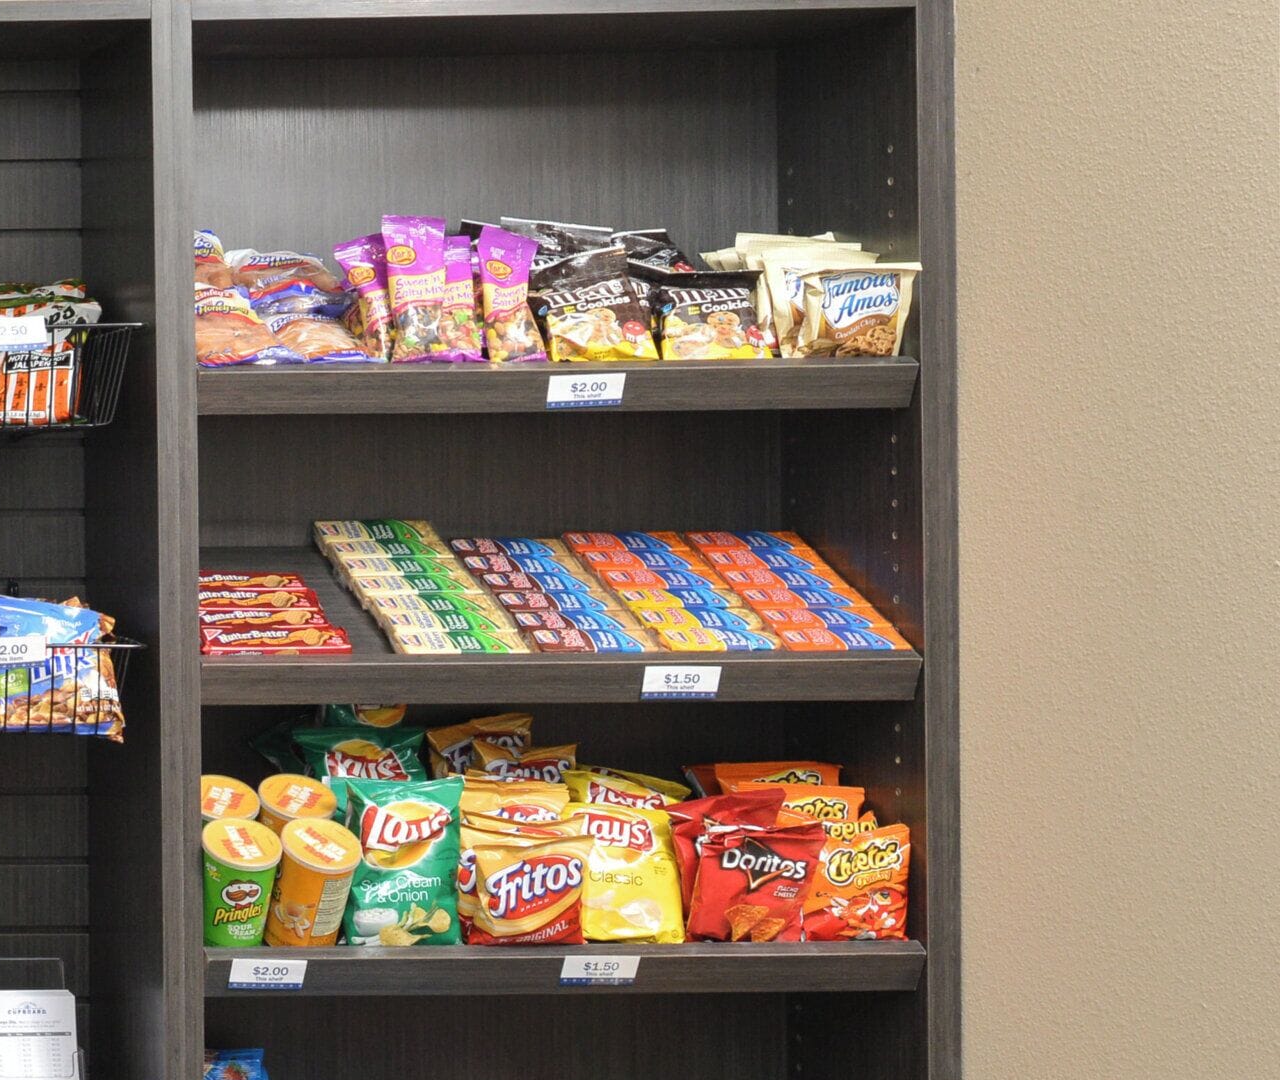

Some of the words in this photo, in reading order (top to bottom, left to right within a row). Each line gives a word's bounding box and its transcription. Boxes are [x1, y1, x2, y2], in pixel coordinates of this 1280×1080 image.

[822, 273, 895, 309] Famous
[577, 296, 630, 311] Cookies
[834, 292, 898, 323] Amos
[570, 381, 607, 393] $2.00
[225, 590, 259, 600] Butter
[237, 609, 272, 621] Butter
[219, 630, 253, 644] Nutter
[253, 629, 289, 641] Butter
[663, 672, 700, 685] $1.50
[721, 850, 806, 879] Doritos
[826, 841, 902, 885] Cheetos
[398, 876, 441, 889] Cream
[589, 870, 644, 887] Classic
[389, 889, 429, 902] Onion
[485, 858, 583, 918] Fritos
[214, 904, 263, 927] Pringles
[252, 966, 289, 976] $2.00
[583, 962, 620, 971] $1.50
